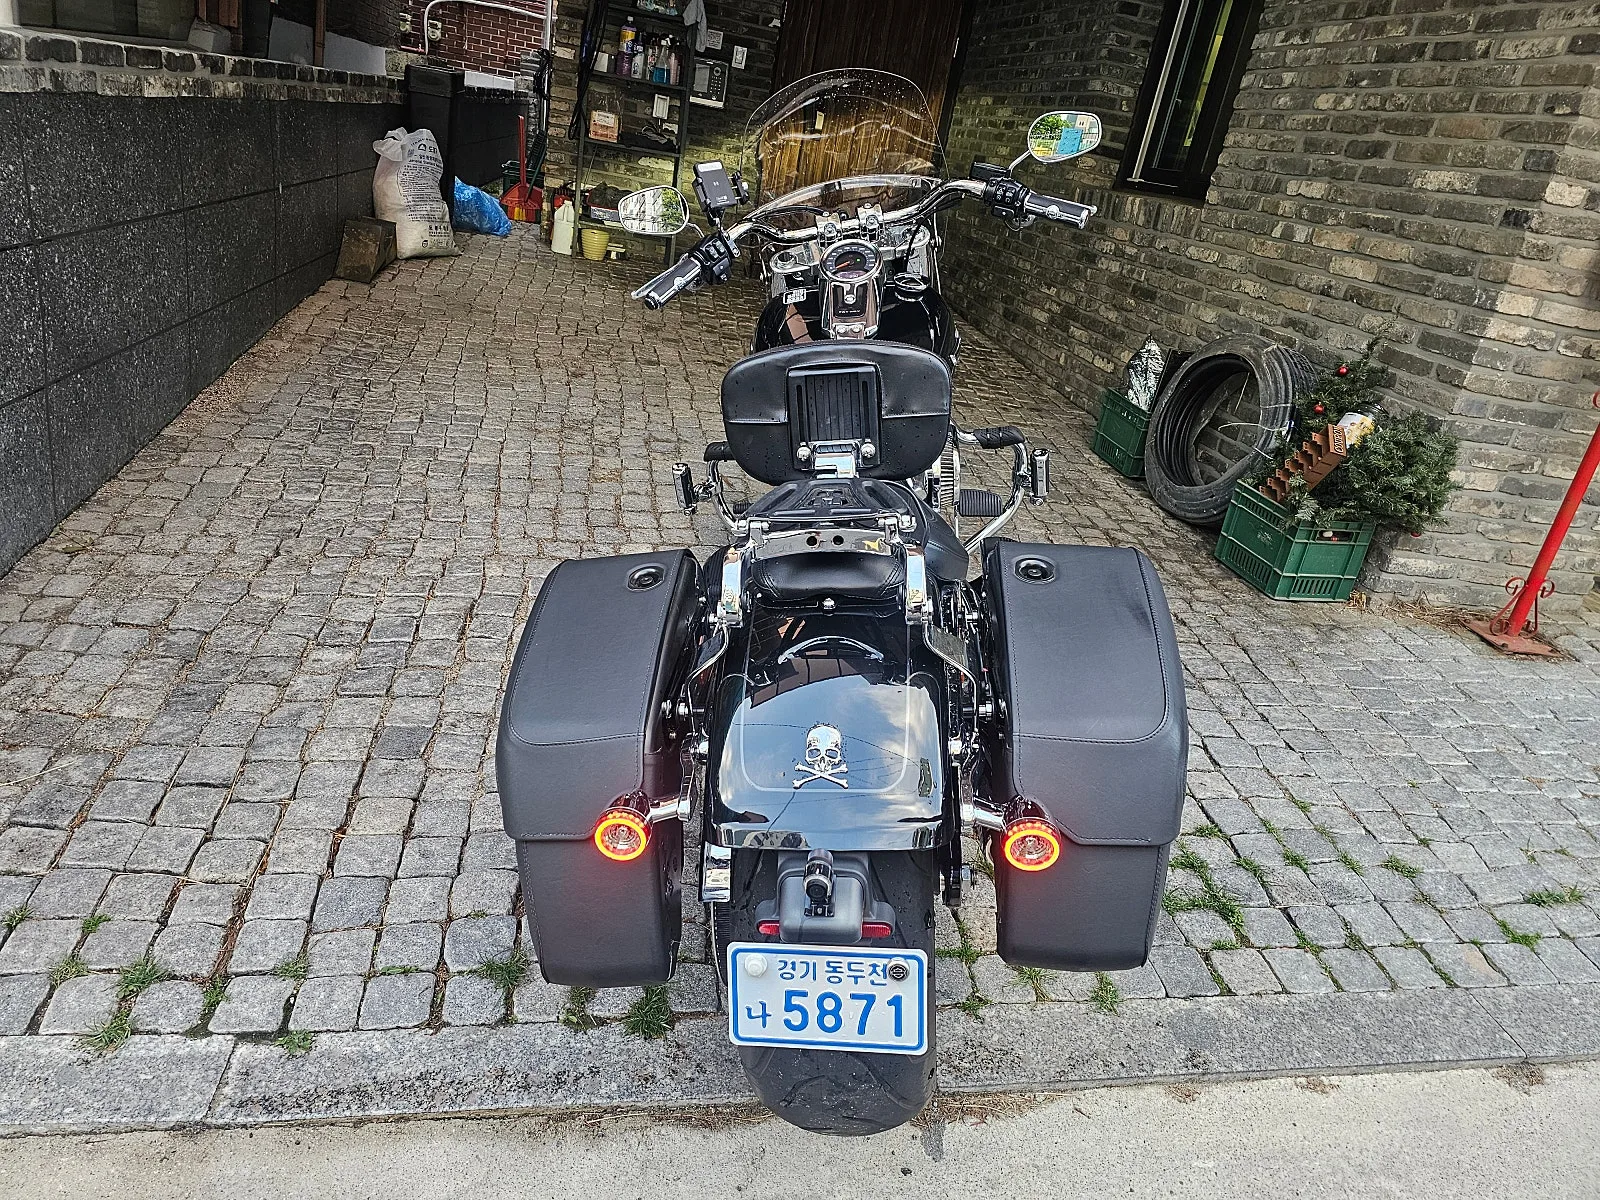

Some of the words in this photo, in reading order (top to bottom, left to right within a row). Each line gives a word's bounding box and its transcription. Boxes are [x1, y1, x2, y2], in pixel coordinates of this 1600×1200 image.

[777, 959, 818, 982] 경기
[824, 960, 888, 986] 동두천
[745, 1000, 772, 1029] 나
[783, 989, 903, 1038] 5871
